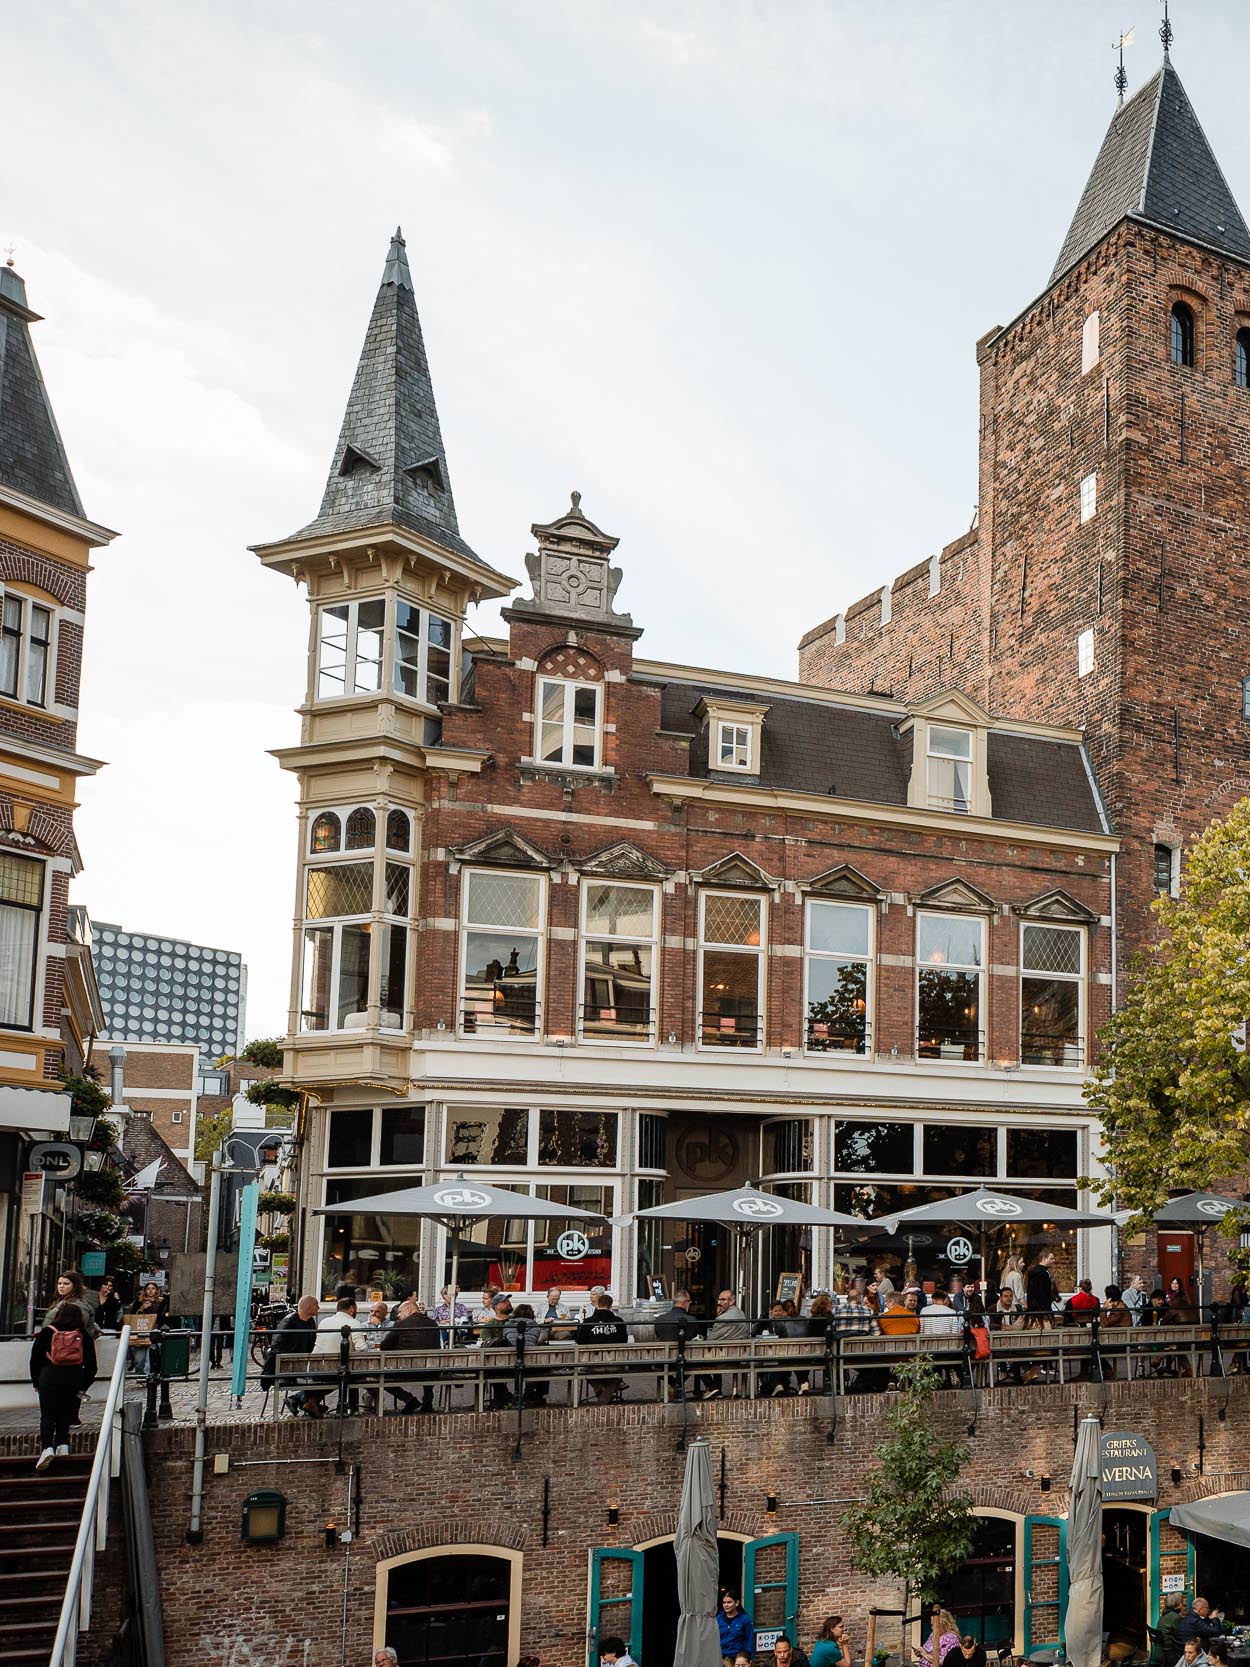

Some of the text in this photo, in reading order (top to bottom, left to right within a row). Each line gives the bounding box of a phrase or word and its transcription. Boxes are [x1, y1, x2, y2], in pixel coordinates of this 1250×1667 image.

[687, 1128, 730, 1173] pk
[32, 1156, 77, 1166] ONLY
[442, 1191, 485, 1207] pk
[982, 1199, 1014, 1214] pk
[741, 1199, 777, 1216] pk
[561, 1233, 585, 1255] pk
[951, 1239, 970, 1259] pk
[1106, 1439, 1137, 1449] GRIEKS
[1102, 1448, 1147, 1458] ESTAURANT
[1102, 1466, 1153, 1482] AVERNA
